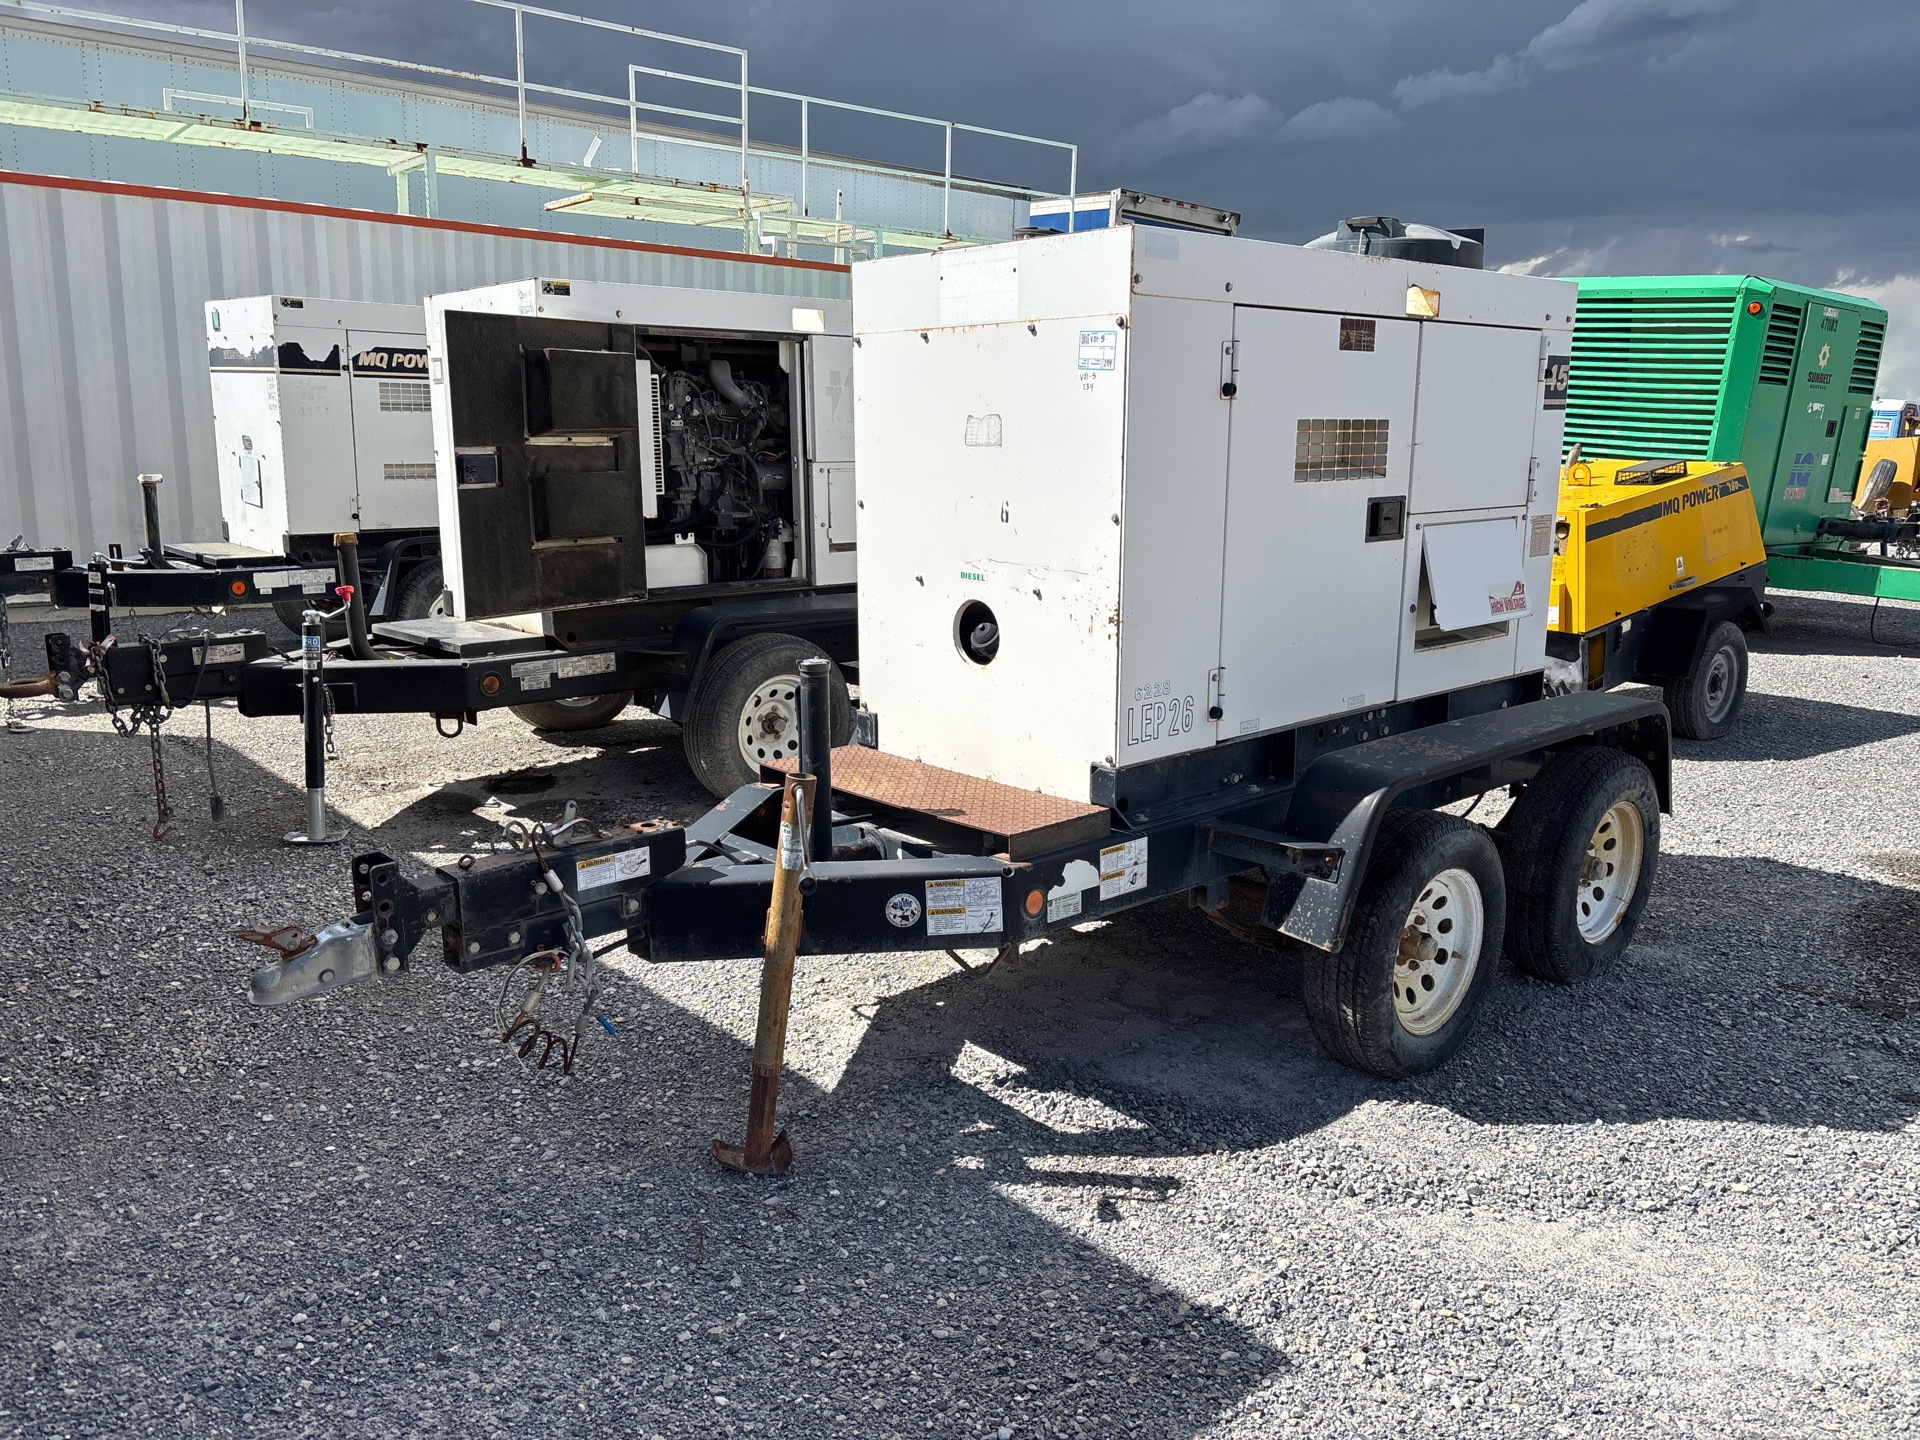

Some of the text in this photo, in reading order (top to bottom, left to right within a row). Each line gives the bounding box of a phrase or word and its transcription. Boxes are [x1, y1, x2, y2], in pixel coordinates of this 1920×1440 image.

[358, 351, 389, 369] MQ
[1545, 364, 1569, 391] 45
[1807, 371, 1833, 385] SUNBELT
[1662, 496, 1680, 517] MQ
[1682, 484, 1719, 511] POWER
[960, 571, 986, 583] DIESEL
[1490, 597, 1527, 614] HIGH VOLTAGE
[1134, 679, 1171, 702] 6228
[1127, 694, 1195, 747] LEP26
[586, 857, 611, 867] WARNING
[934, 880, 960, 888] WARNING
